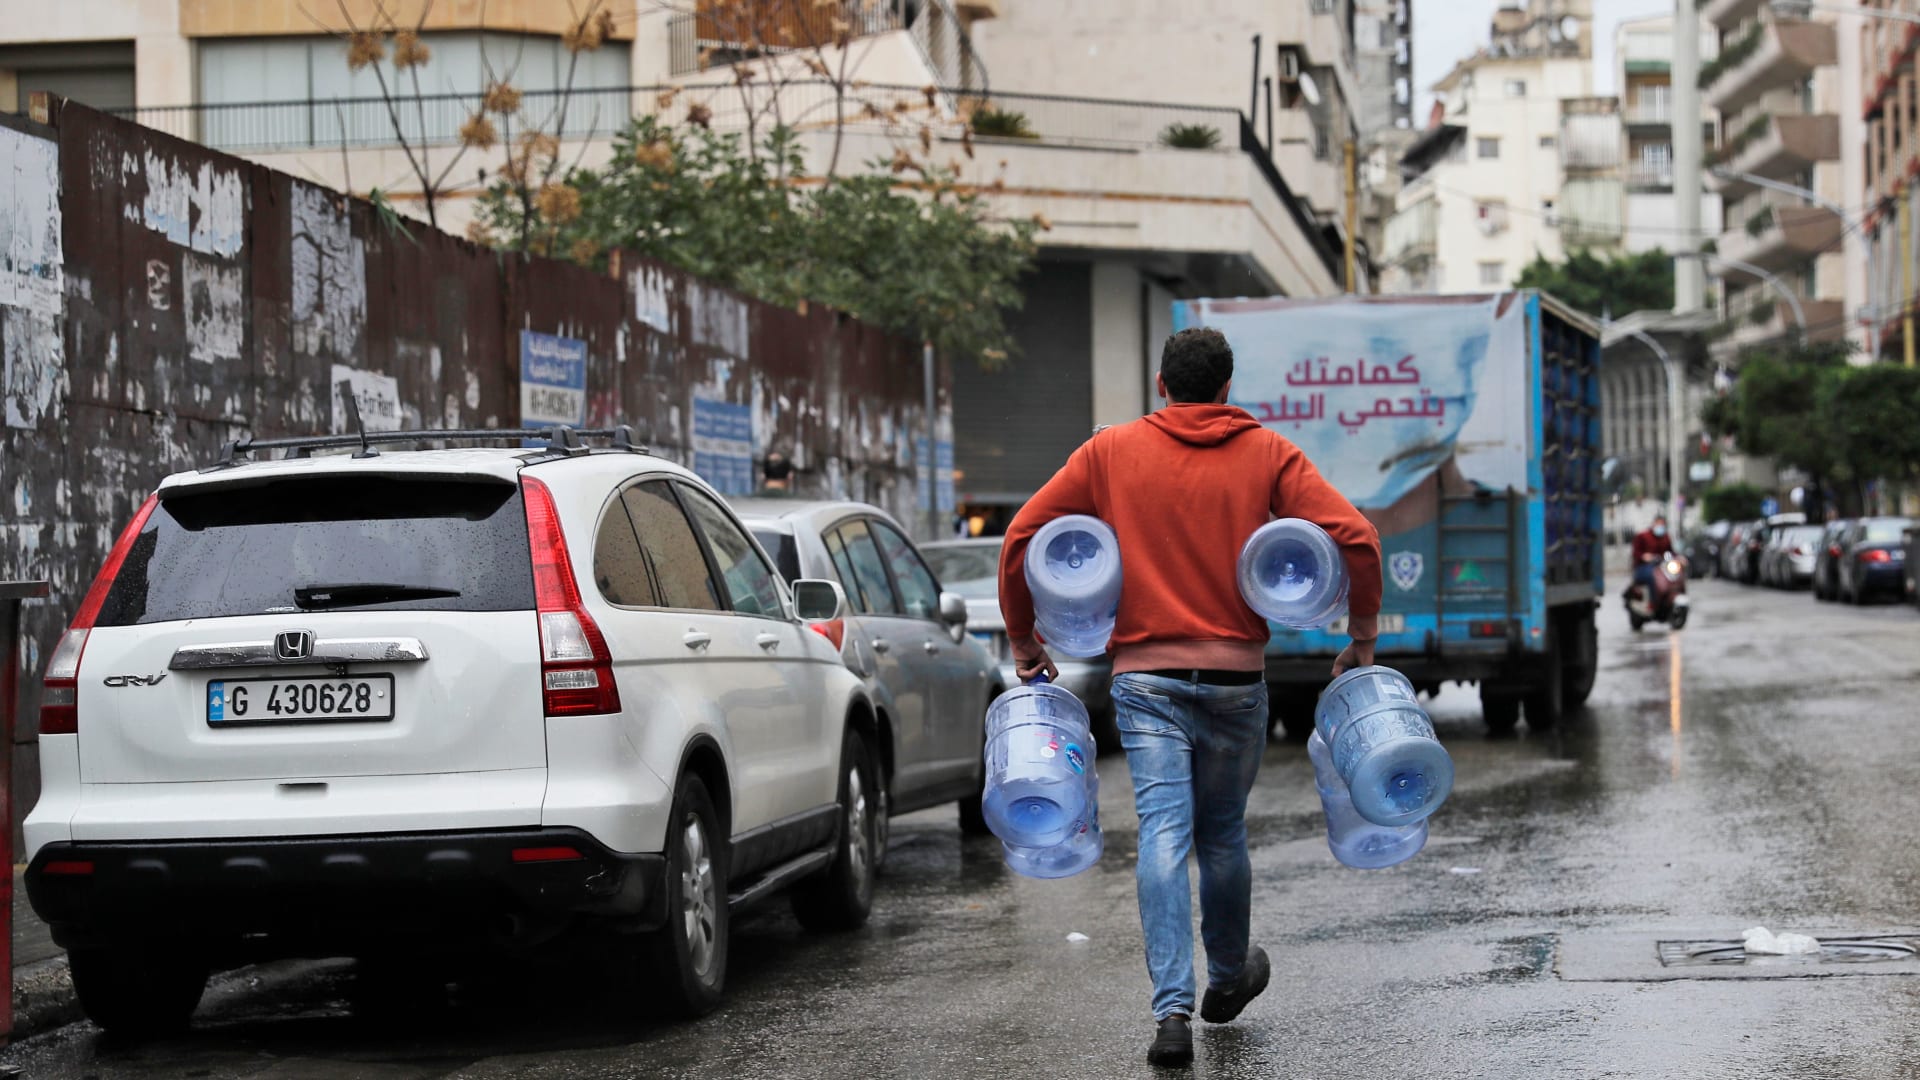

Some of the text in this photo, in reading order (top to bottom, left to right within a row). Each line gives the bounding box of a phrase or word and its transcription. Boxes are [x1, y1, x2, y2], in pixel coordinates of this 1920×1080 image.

[1286, 354, 1420, 386] كمامتك
[1257, 388, 1446, 435] بتحمي البلد
[232, 682, 372, 716] G 430628
